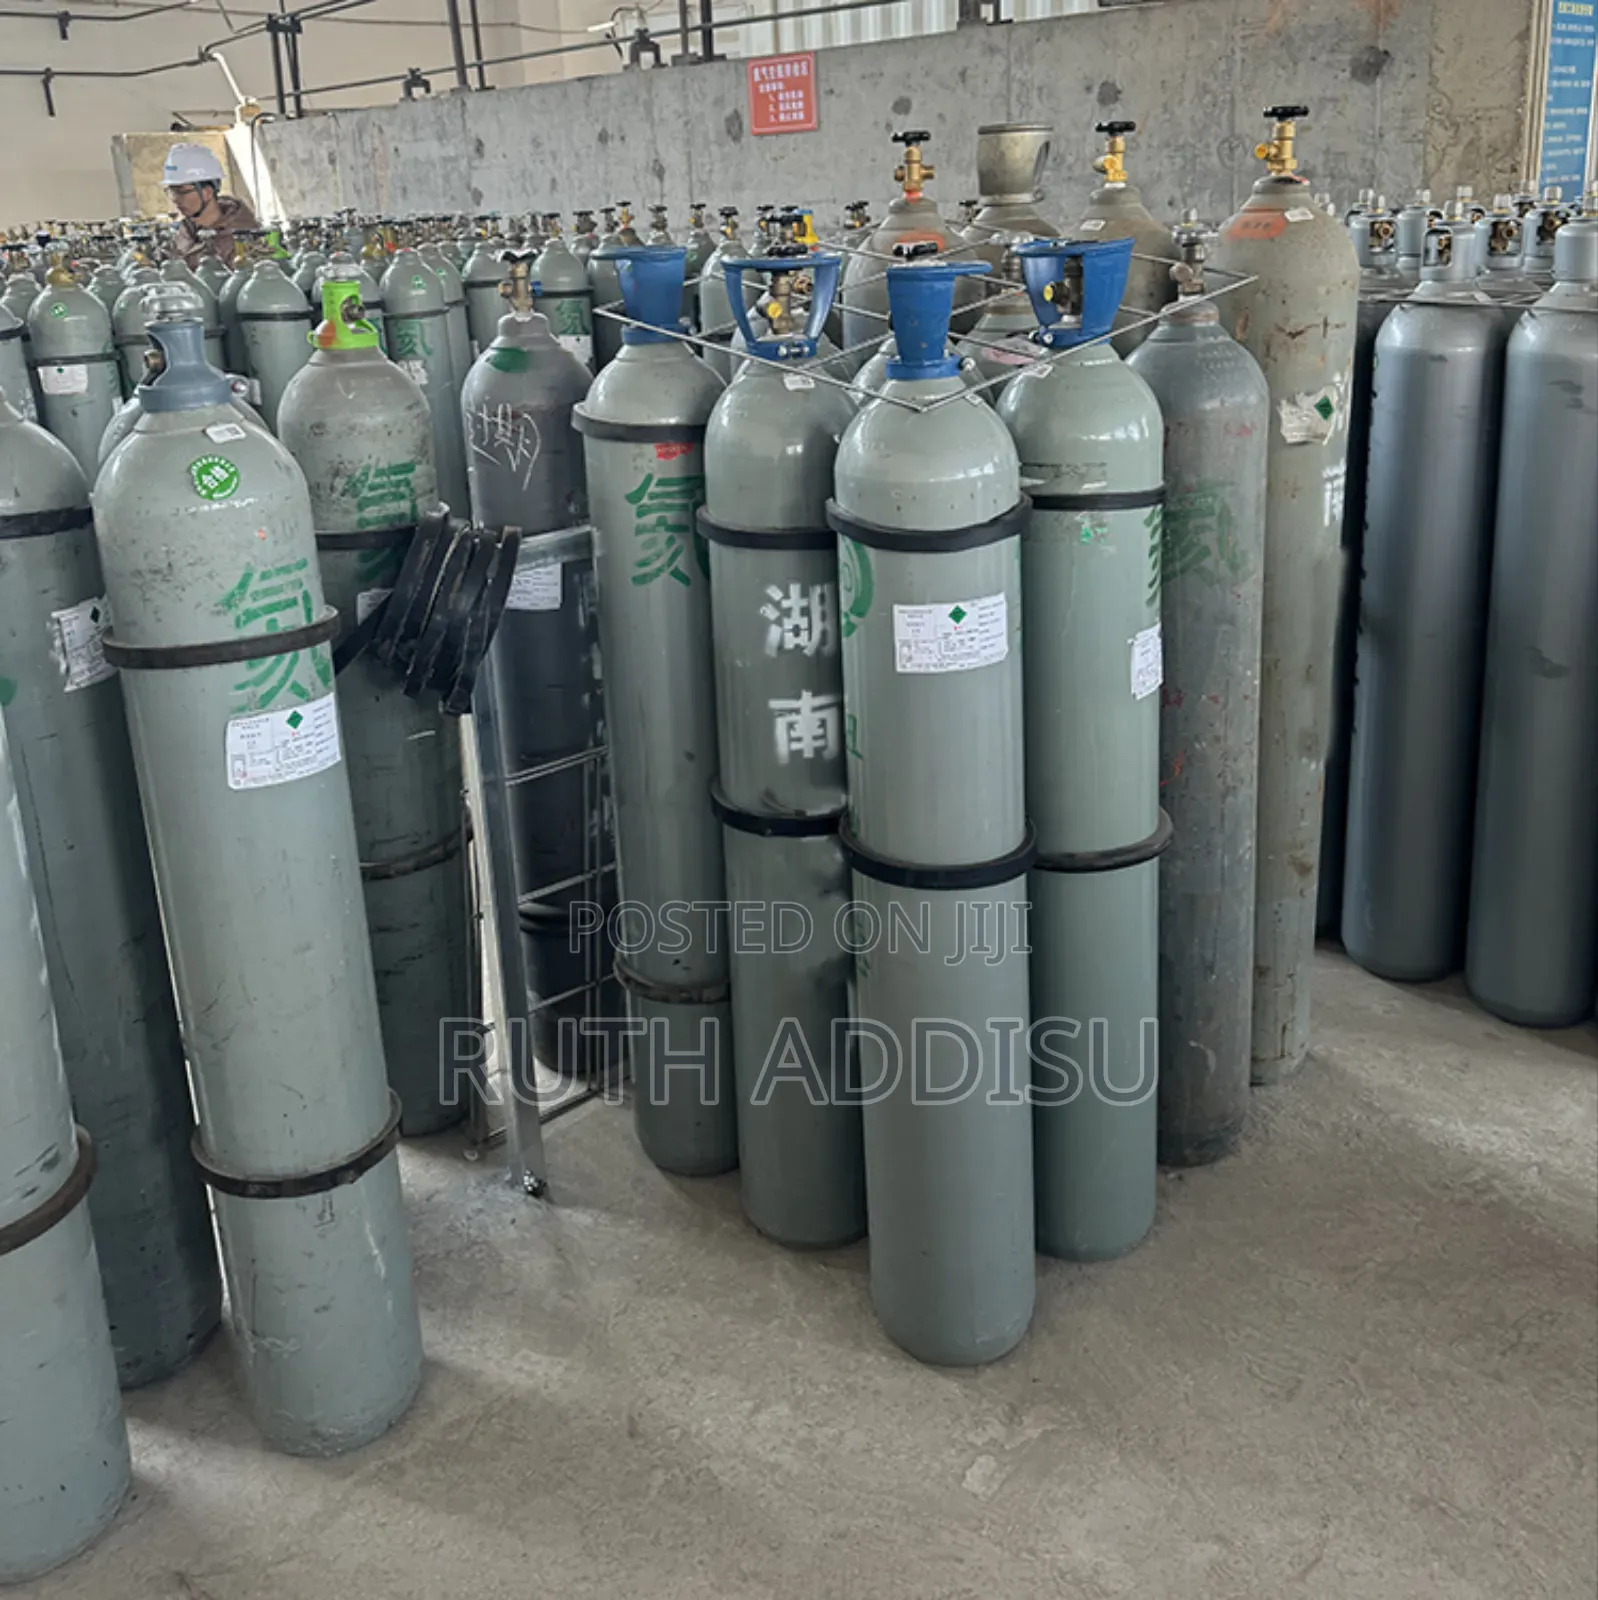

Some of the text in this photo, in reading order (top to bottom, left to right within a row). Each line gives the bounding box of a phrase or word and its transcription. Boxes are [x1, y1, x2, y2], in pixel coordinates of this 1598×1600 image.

[624, 472, 711, 588] 氦
[221, 561, 332, 712] 氦
[759, 582, 843, 767] 湖南
